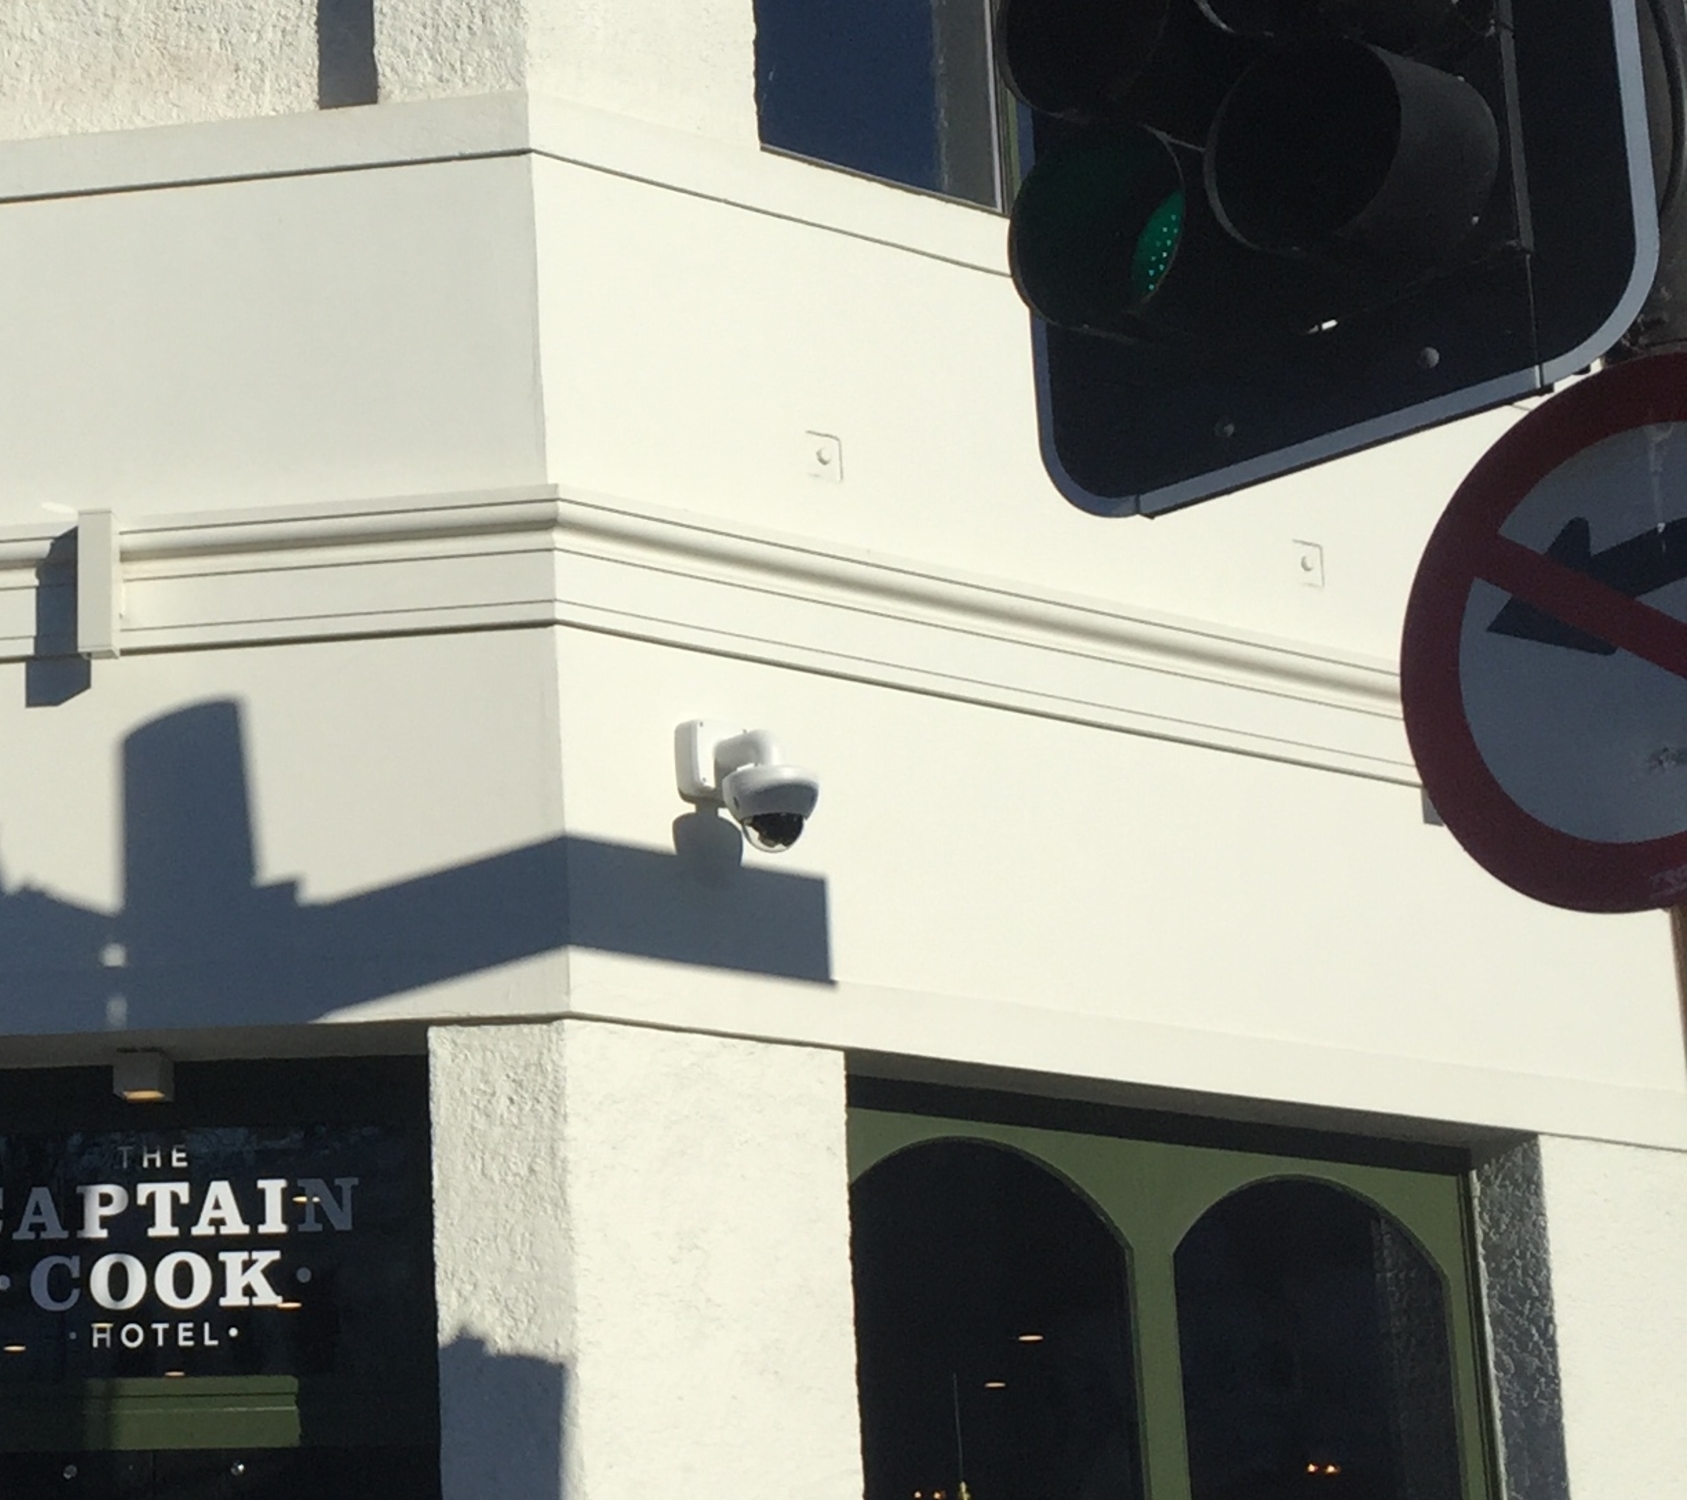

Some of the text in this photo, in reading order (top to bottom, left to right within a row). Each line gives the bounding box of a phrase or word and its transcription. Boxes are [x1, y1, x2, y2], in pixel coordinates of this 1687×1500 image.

[117, 1145, 190, 1169] THE
[29, 1249, 283, 1312] COOK
[91, 1321, 220, 1349] HOTEL
